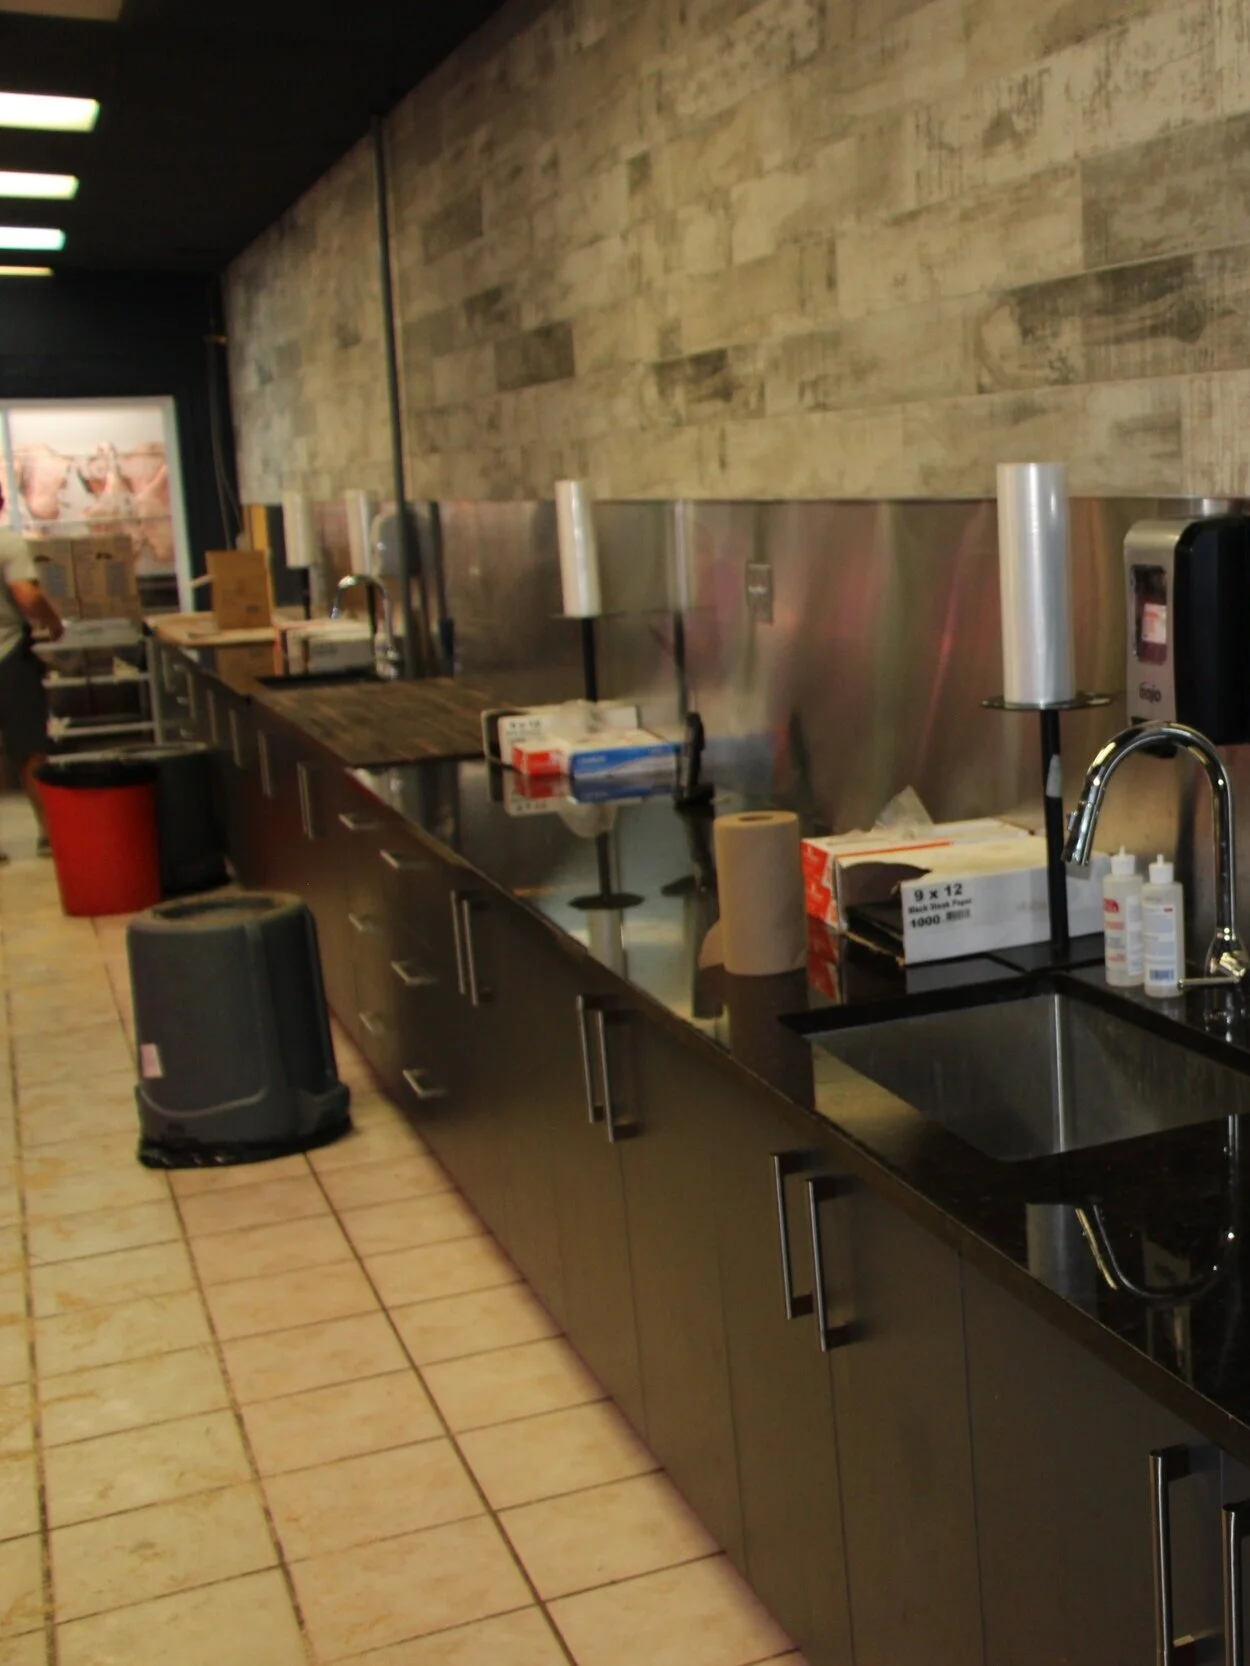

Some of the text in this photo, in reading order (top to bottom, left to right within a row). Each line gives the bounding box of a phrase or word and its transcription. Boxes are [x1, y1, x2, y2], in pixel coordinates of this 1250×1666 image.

[914, 883, 963, 902] 9 x 12
[911, 914, 940, 928] 1000
